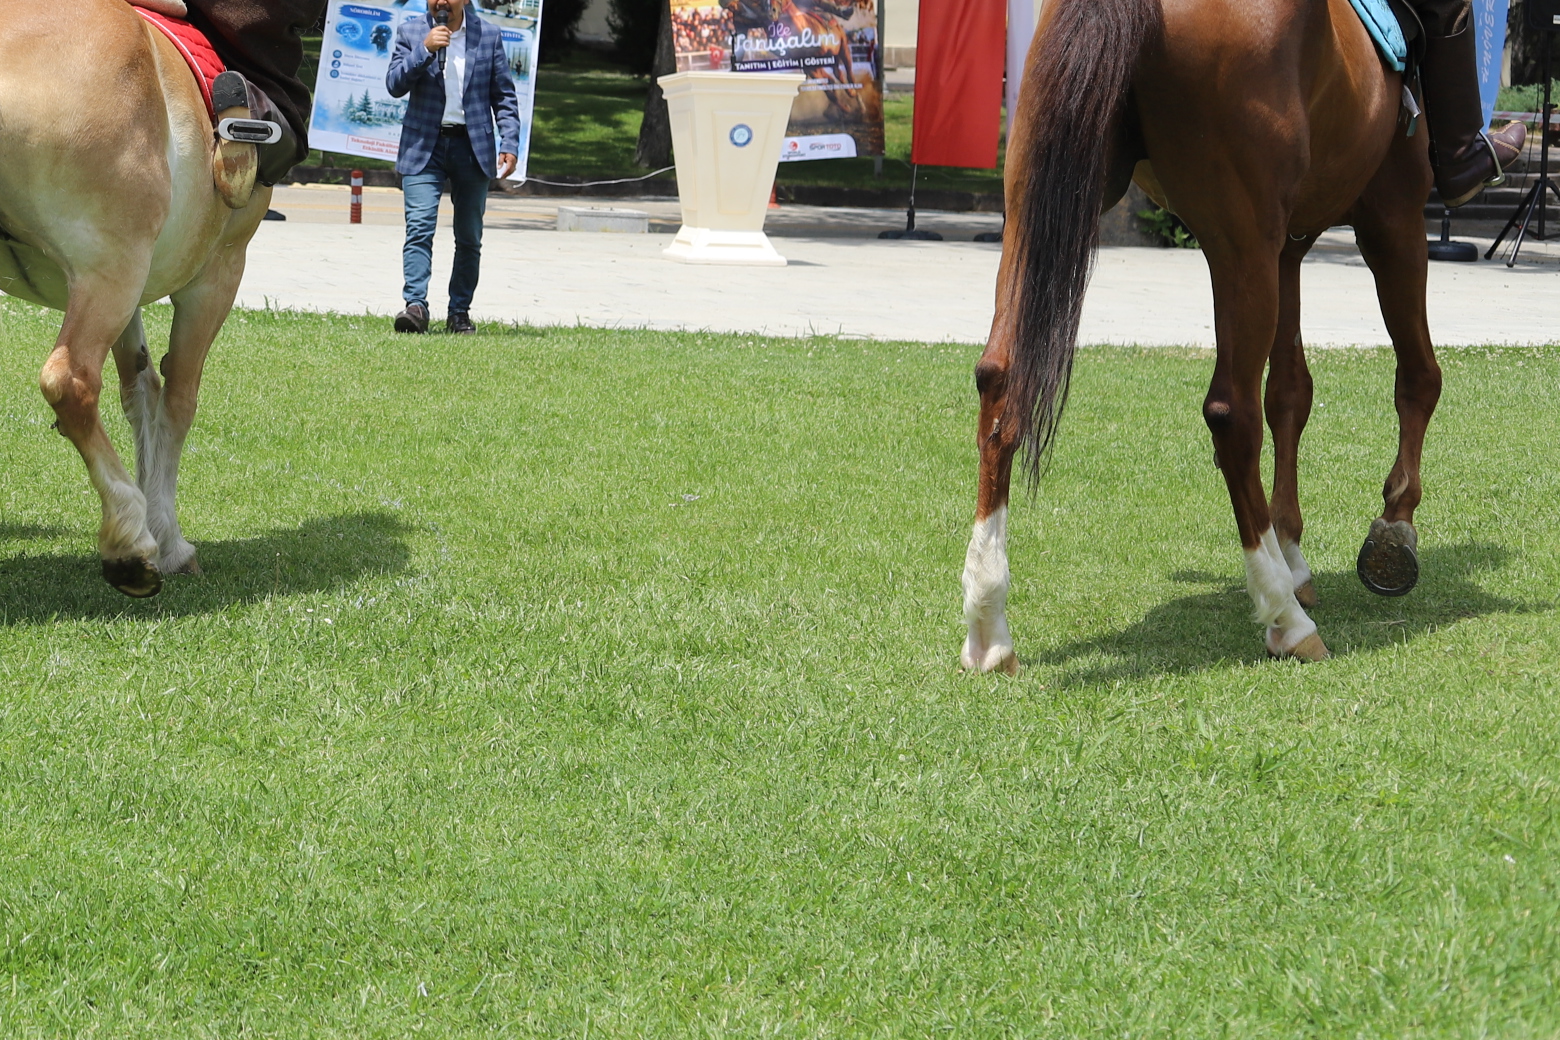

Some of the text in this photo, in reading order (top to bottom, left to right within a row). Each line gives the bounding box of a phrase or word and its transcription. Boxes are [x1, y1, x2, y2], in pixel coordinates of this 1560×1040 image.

[728, 27, 840, 56] Tanışalım
[735, 61, 767, 71] TANITIM
[804, 56, 835, 66] GÖSTERİ
